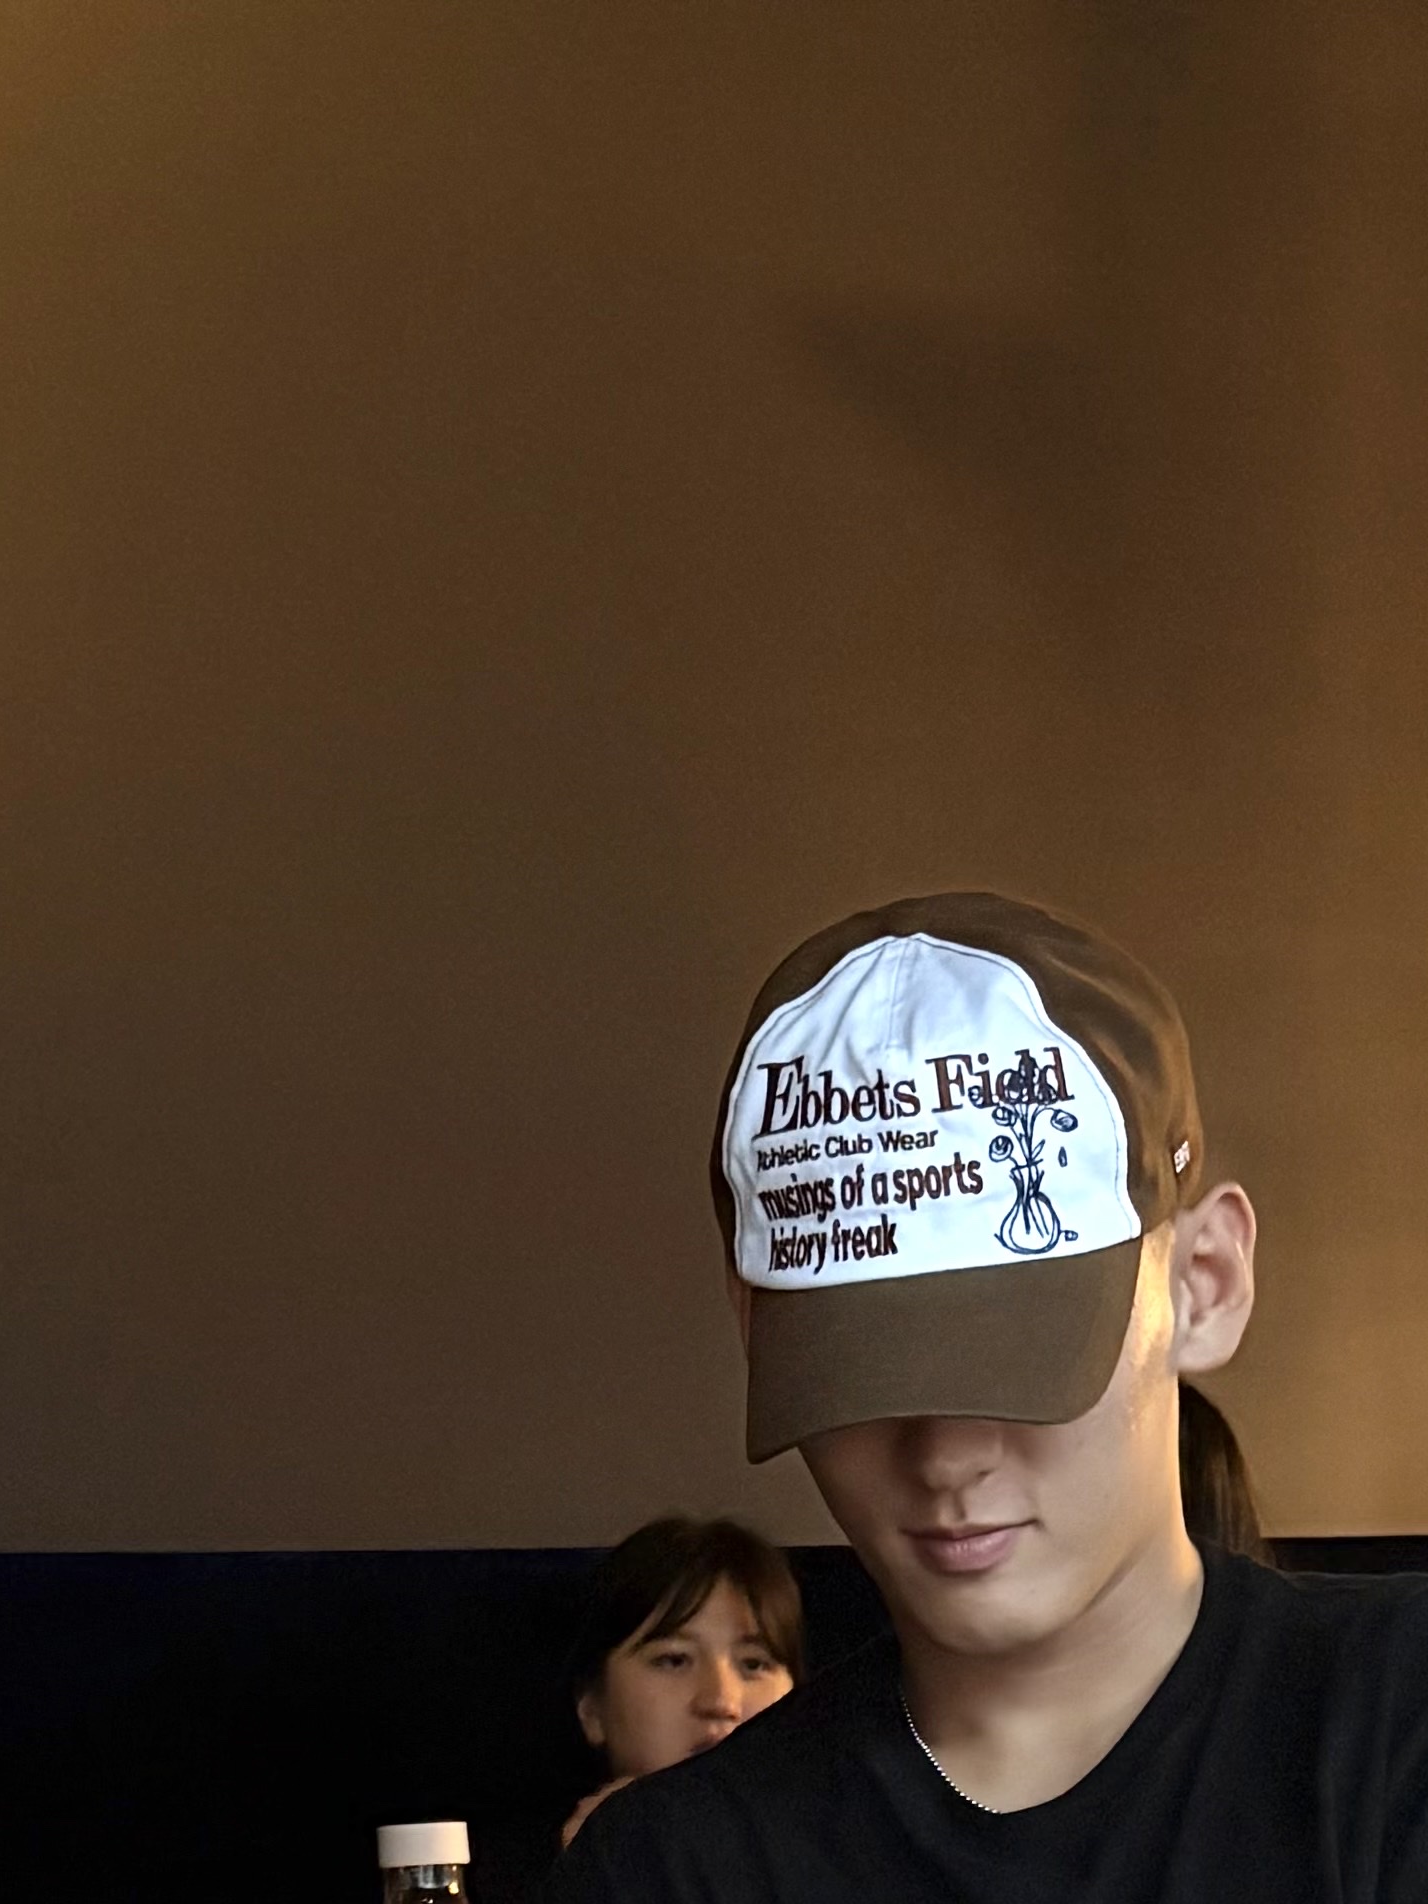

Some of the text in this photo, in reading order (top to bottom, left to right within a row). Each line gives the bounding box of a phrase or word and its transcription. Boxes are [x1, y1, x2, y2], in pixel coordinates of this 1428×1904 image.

[751, 1047, 1075, 1141] Ebbets Field
[825, 1133, 873, 1158] Club
[877, 1130, 939, 1153] Wear
[758, 1151, 984, 1223] musings of a sports
[768, 1213, 899, 1275] history freak
